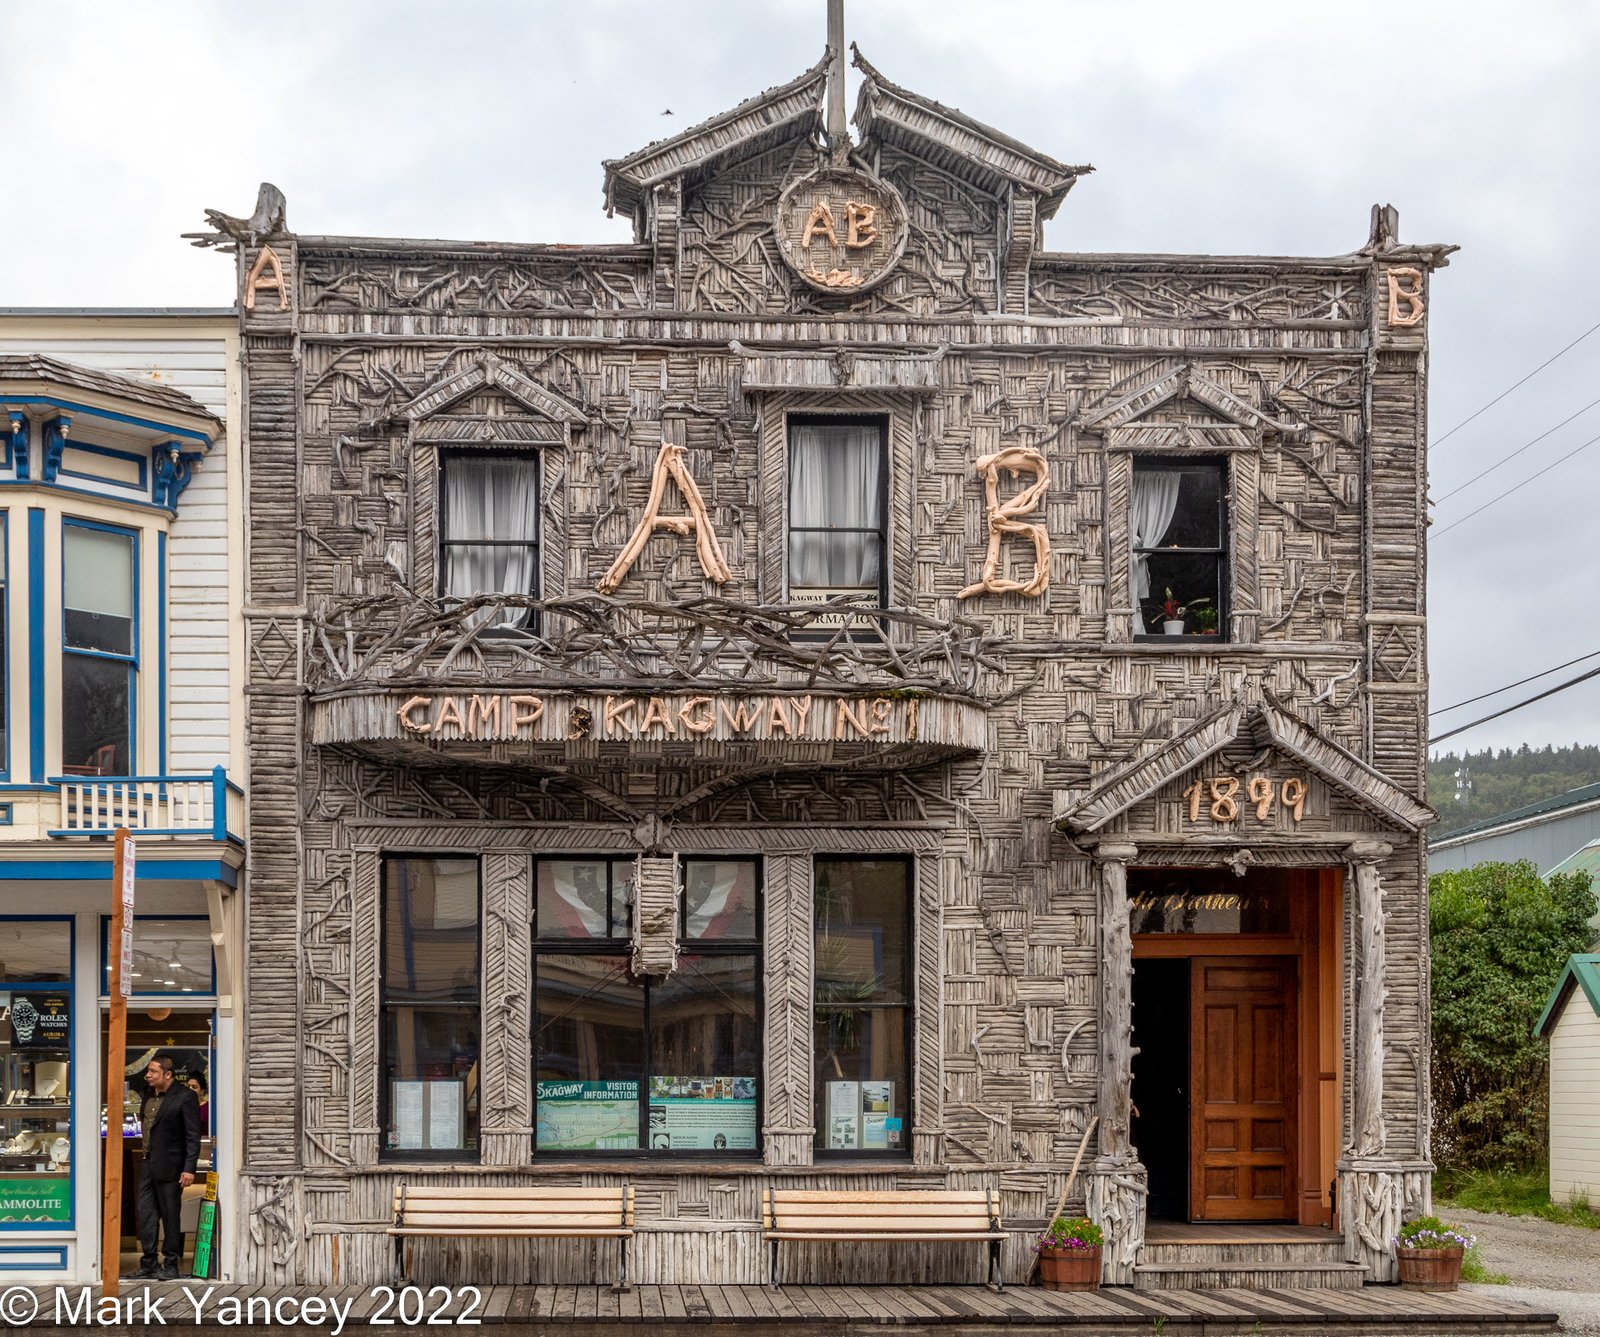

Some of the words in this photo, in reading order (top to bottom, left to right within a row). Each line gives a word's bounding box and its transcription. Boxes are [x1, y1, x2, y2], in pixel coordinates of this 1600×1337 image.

[243, 243, 289, 310] A
[1387, 267, 1426, 326] B
[397, 694, 544, 738] CAMP
[1183, 776, 1309, 823] 1899
[536, 1083, 584, 1100] SKAGWAY
[606, 1082, 638, 1091] VISITOR
[583, 1091, 638, 1100] INFORMATION
